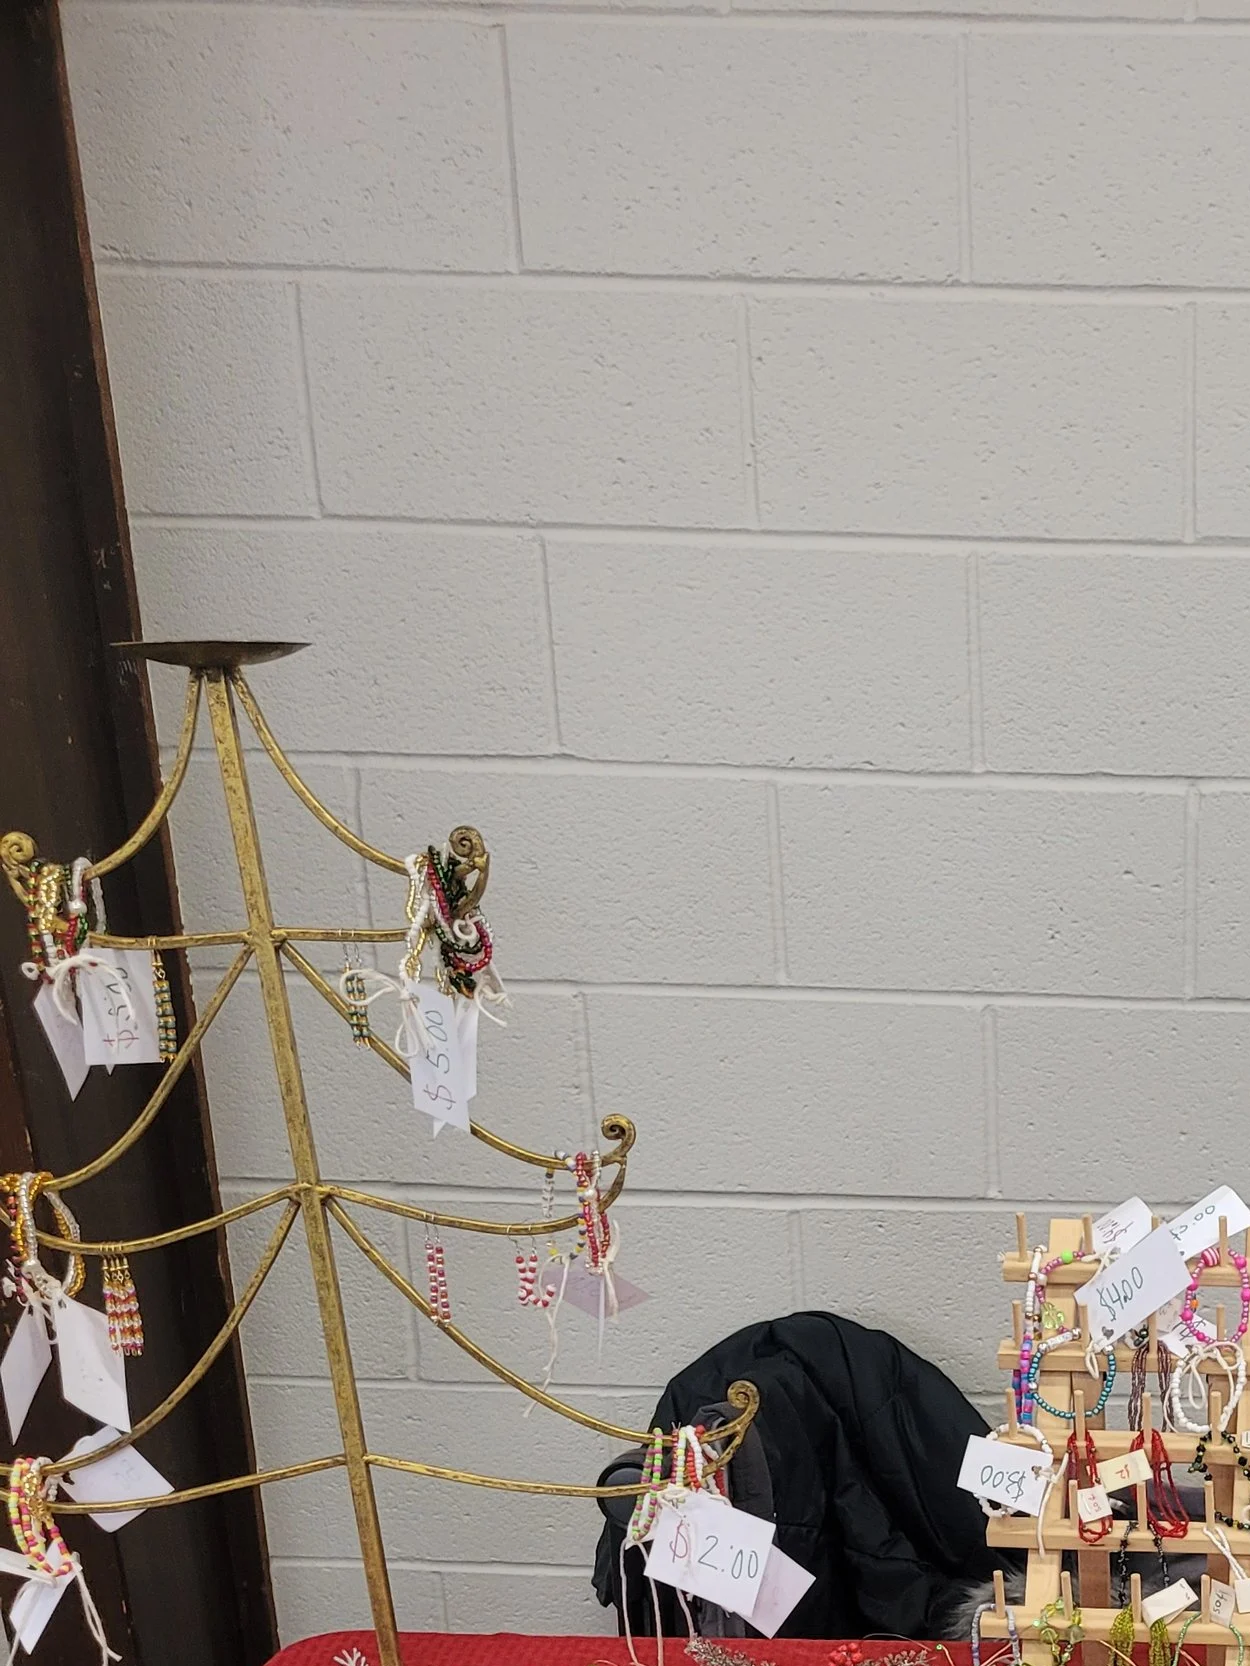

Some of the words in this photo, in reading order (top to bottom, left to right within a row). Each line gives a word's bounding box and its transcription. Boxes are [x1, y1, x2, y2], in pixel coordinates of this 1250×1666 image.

[423, 1010, 456, 1110] $5.00
[1097, 1266, 1144, 1322] $4.00
[669, 1519, 760, 1580] $2.00
